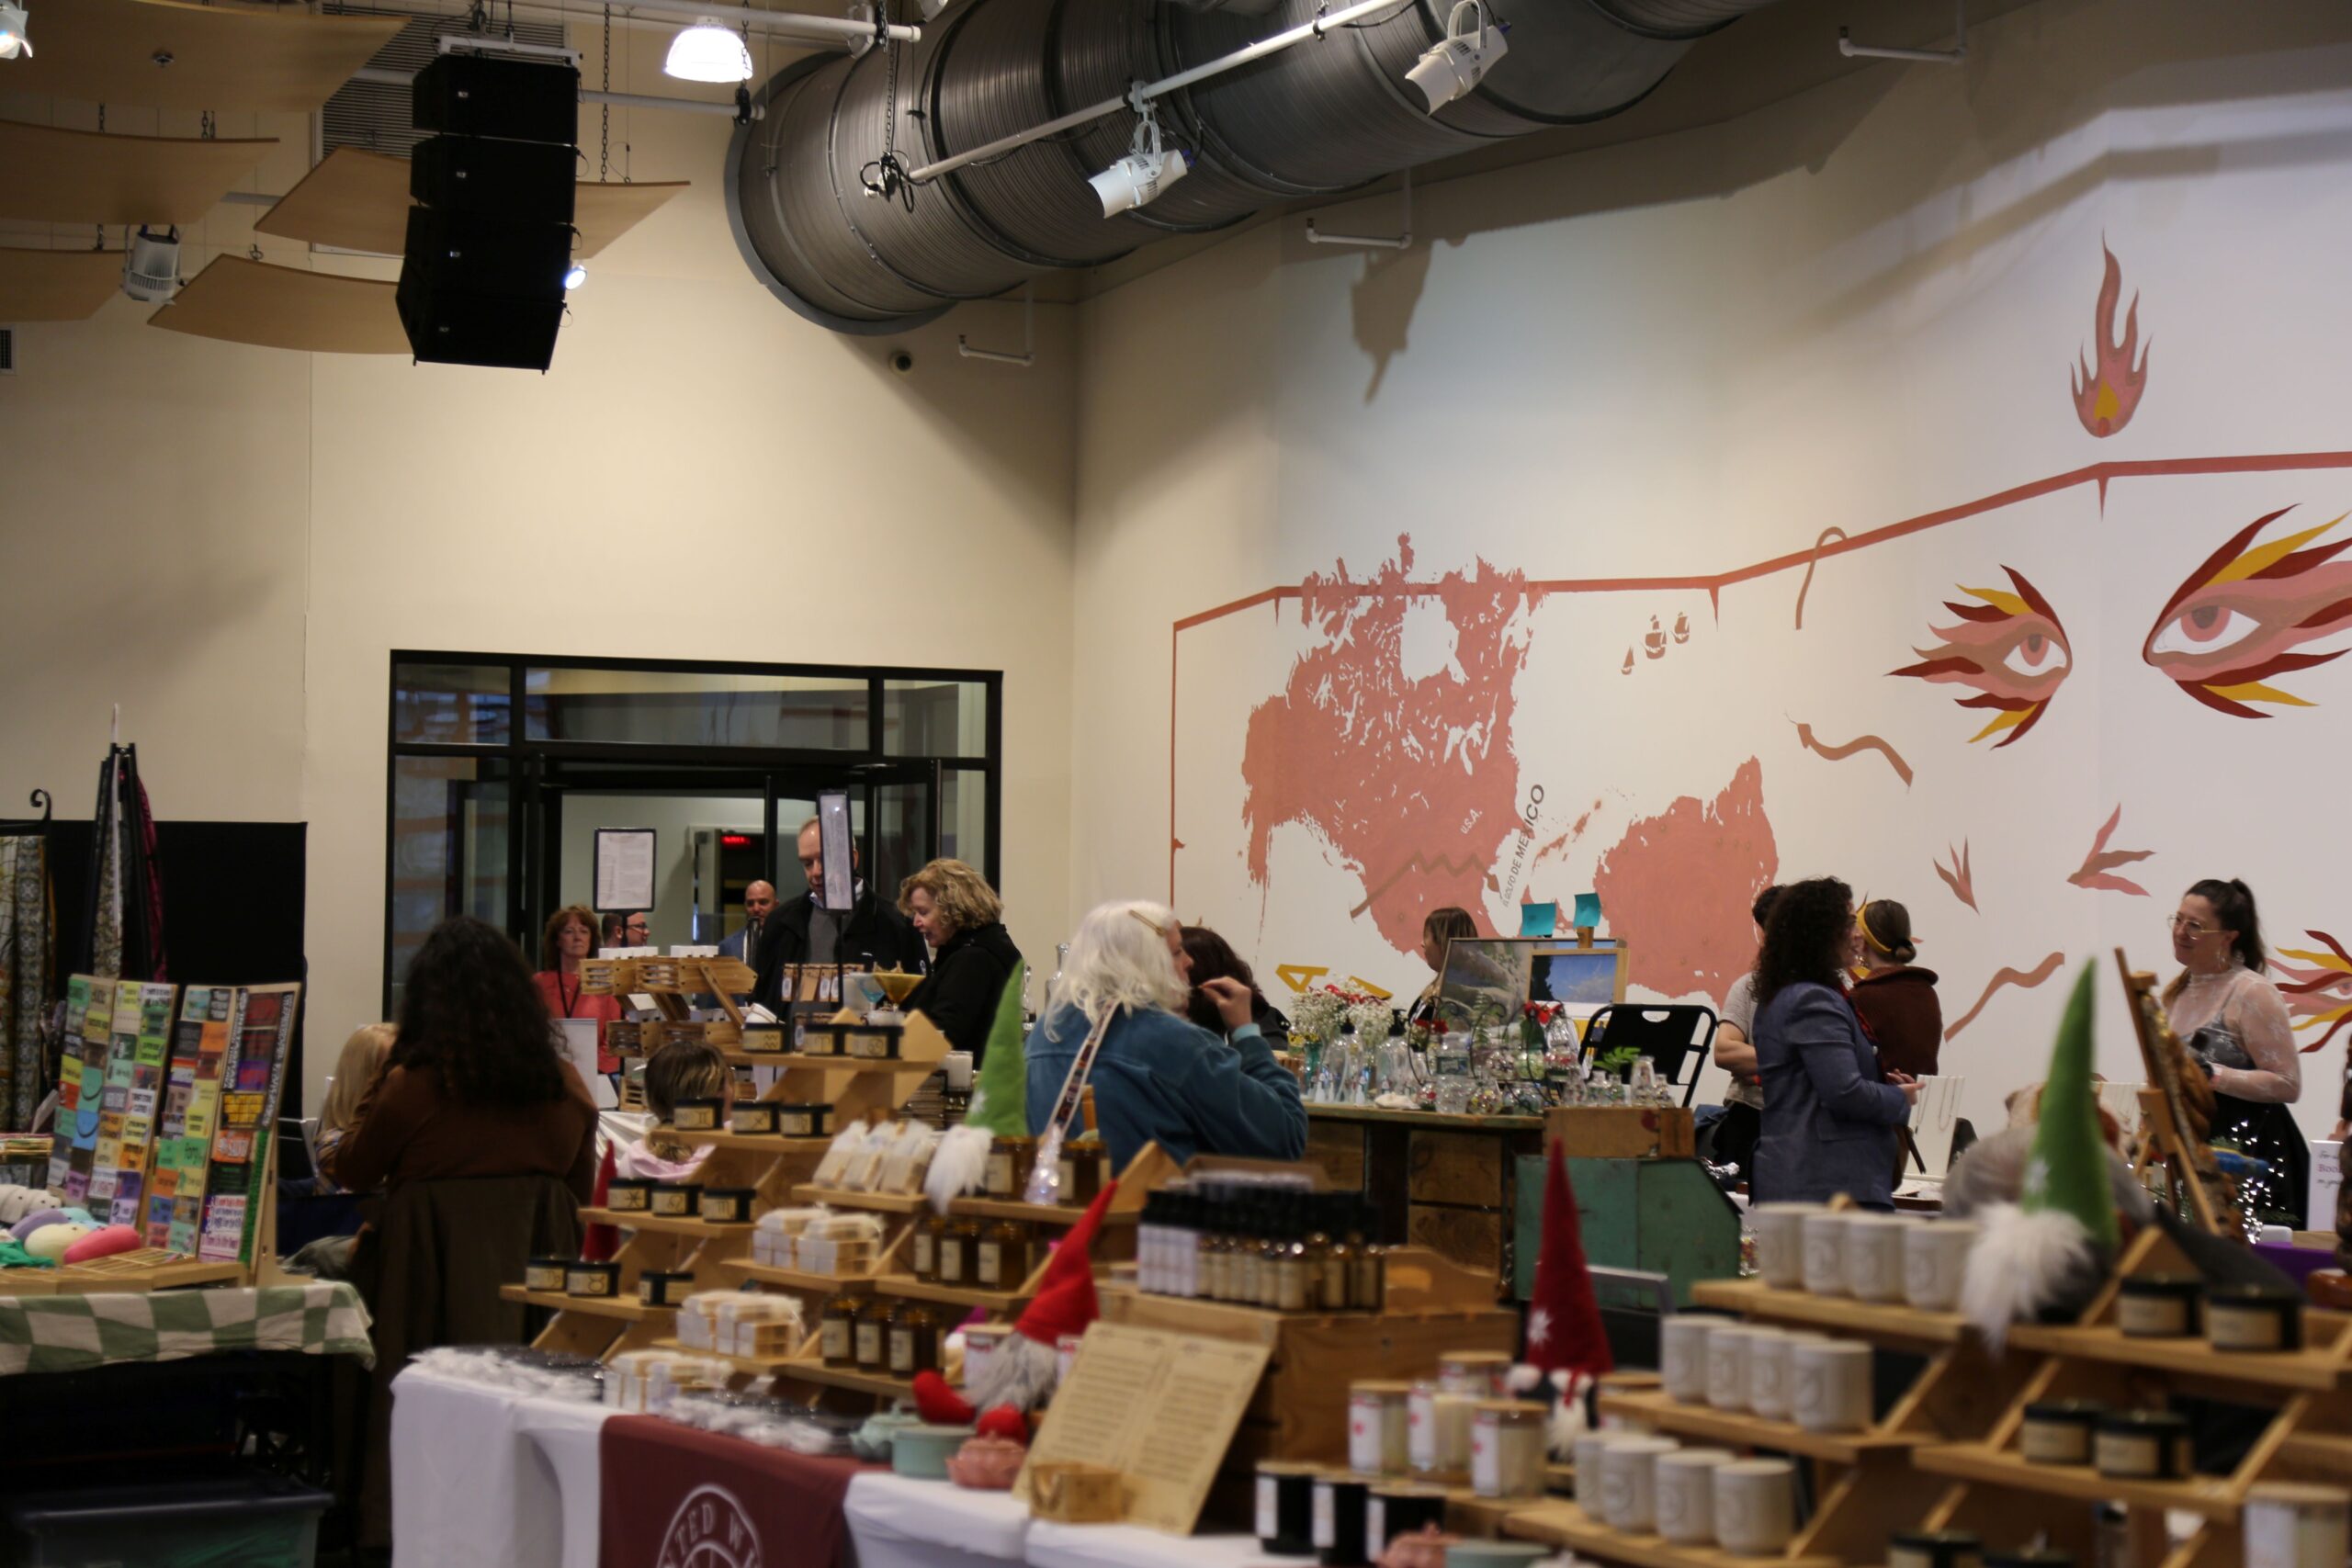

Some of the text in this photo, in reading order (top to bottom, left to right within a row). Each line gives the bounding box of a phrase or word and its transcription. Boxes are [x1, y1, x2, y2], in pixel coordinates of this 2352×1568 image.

[1460, 808, 1483, 834] U.S.A.
[1510, 858, 1522, 875] DE
[1516, 784, 1544, 859] MEXICO
